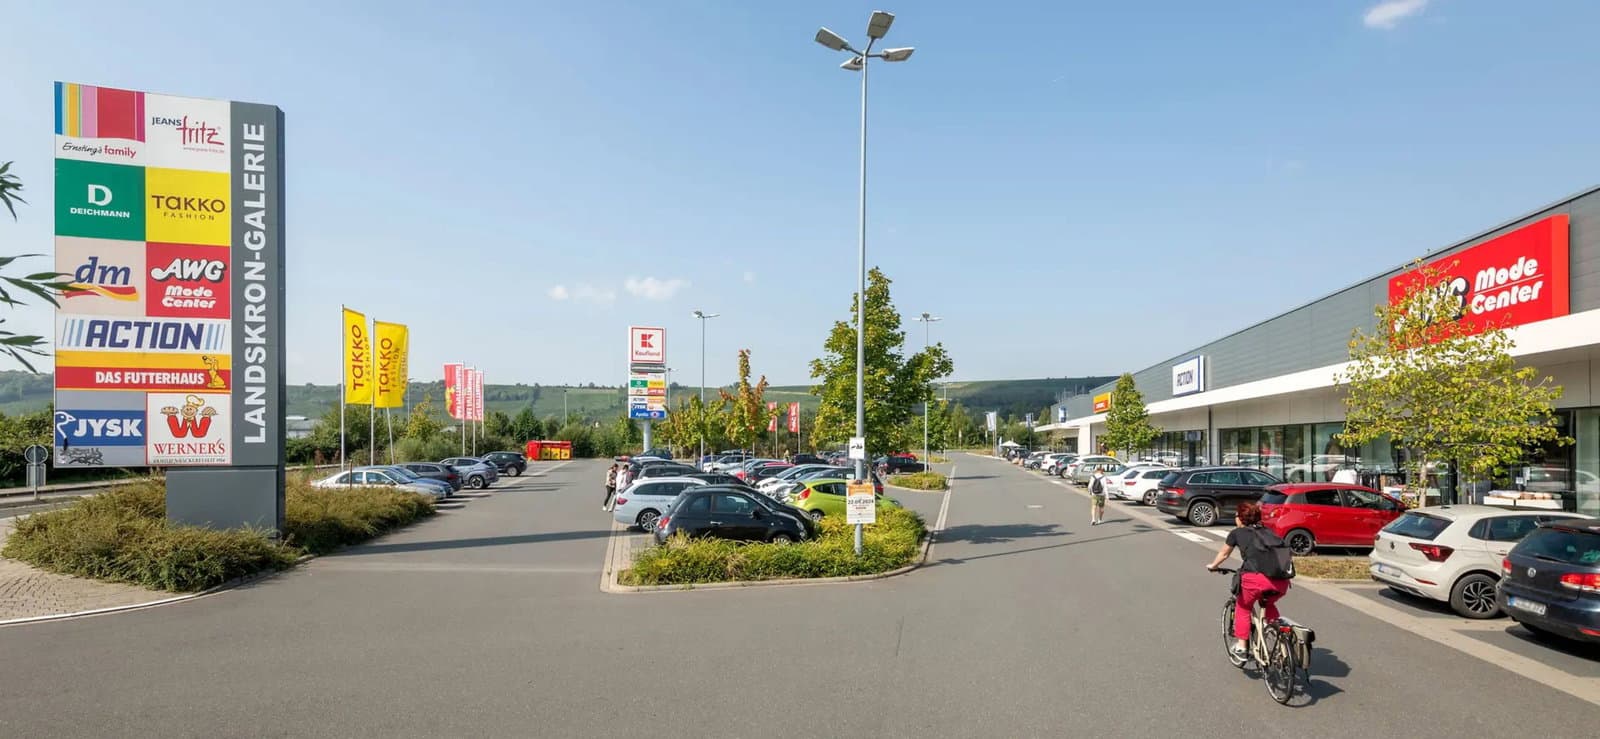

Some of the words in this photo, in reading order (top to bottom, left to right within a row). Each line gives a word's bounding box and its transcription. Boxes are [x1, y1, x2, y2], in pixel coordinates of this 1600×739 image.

[152, 116, 182, 126] JEANS
[176, 115, 224, 145] fritz
[62, 142, 102, 156] Ernsting's
[104, 145, 136, 158] family
[88, 184, 112, 206] D
[70, 207, 130, 218] DEICHMANN
[163, 212, 215, 221] FASHION
[75, 257, 130, 286] dm
[151, 258, 226, 282] AWG
[1474, 256, 1538, 292] Mode
[165, 285, 213, 298] Mode
[243, 123, 266, 443] LANDSKRON-GALERIE
[161, 298, 216, 309] Center
[1471, 281, 1543, 315] Center
[85, 319, 204, 350] ACTION
[95, 371, 122, 384] DAS
[124, 372, 204, 385] FUTTERHAUS
[1176, 369, 1193, 387] ACTION
[73, 419, 142, 437] JYSK
